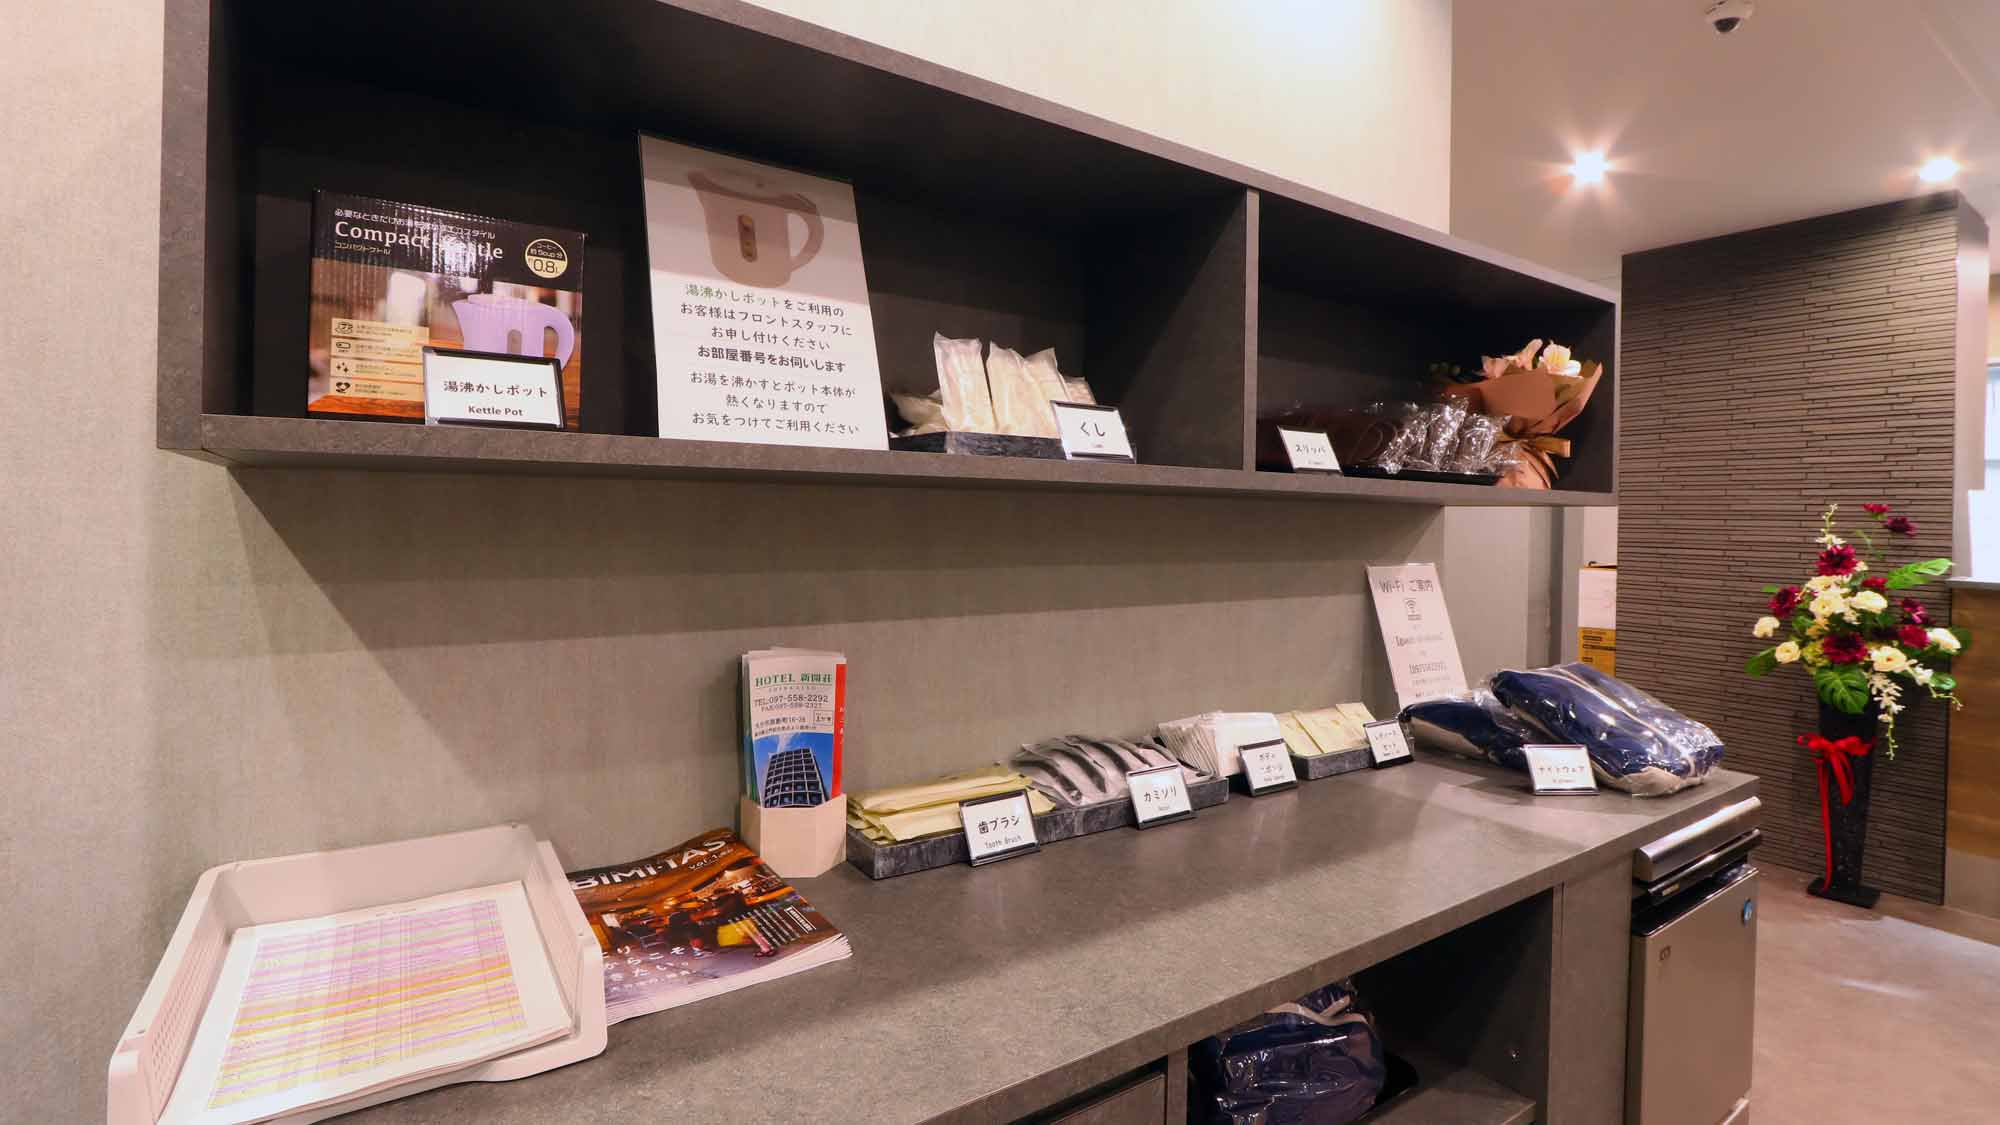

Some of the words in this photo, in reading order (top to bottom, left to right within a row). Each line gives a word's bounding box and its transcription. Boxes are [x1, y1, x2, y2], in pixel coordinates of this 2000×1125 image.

[335, 221, 430, 250] Compact
[680, 303, 853, 337] お客様はフロントスタッフに
[711, 326, 831, 351] お申し付けください
[697, 345, 847, 373] お部屋番号をお伺いします
[468, 405, 502, 416] Kettle
[504, 407, 523, 417] Pot
[725, 393, 829, 414] 熱くなりますので
[691, 412, 860, 435] お気をつけてご利用ください
[1080, 421, 1106, 437] くし
[755, 673, 796, 687] HOTEL
[1143, 785, 1177, 802] カミソリ
[978, 815, 1021, 834] 歯ブラシ
